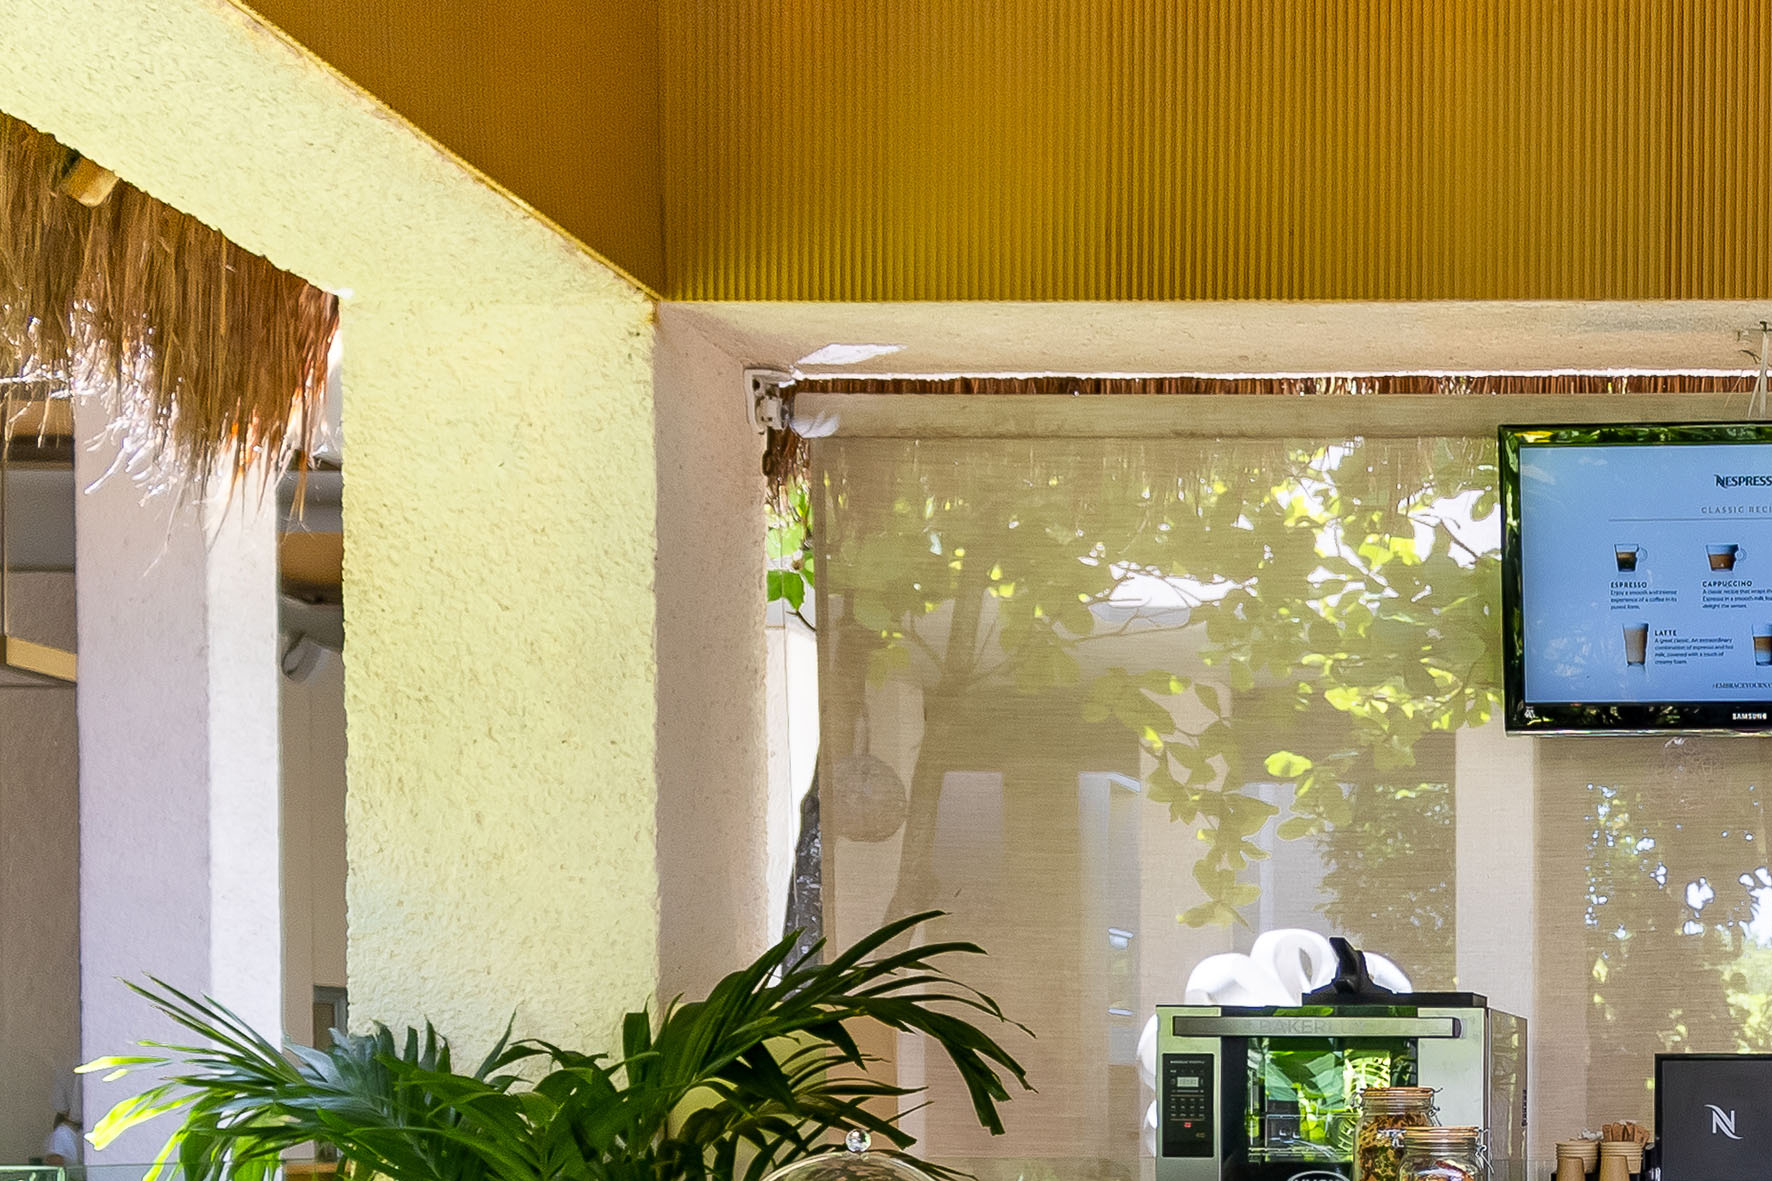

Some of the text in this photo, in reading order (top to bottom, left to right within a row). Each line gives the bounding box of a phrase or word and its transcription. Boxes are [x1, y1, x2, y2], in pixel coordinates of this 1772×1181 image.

[1701, 506, 1744, 514] CLASSIC
[1611, 581, 1647, 589] ESPRESSO
[1732, 712, 1767, 720] SAMSUNG
[1703, 1104, 1744, 1140] N
